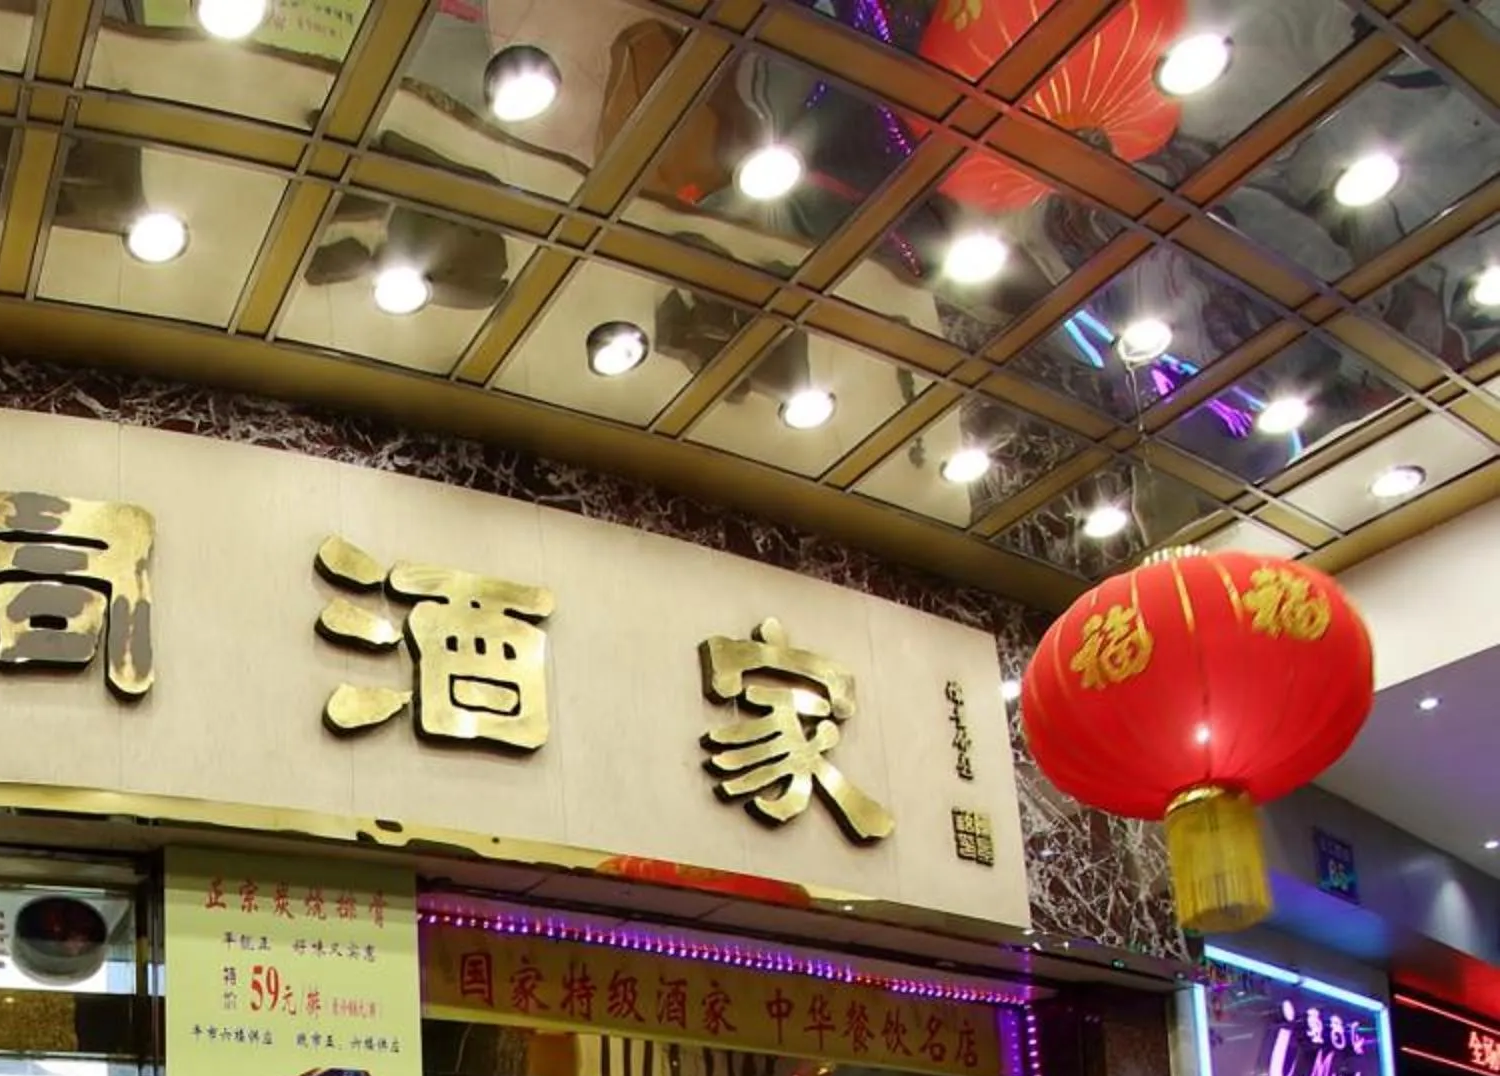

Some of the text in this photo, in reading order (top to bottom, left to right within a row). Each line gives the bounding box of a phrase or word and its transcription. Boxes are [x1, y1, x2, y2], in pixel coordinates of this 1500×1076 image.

[1241, 567, 1332, 641] 福
[1071, 603, 1154, 690] 福
[204, 877, 389, 928] 正宗炭烧排骨
[459, 951, 979, 1068] 国家特级酒家 中华餐饮名店
